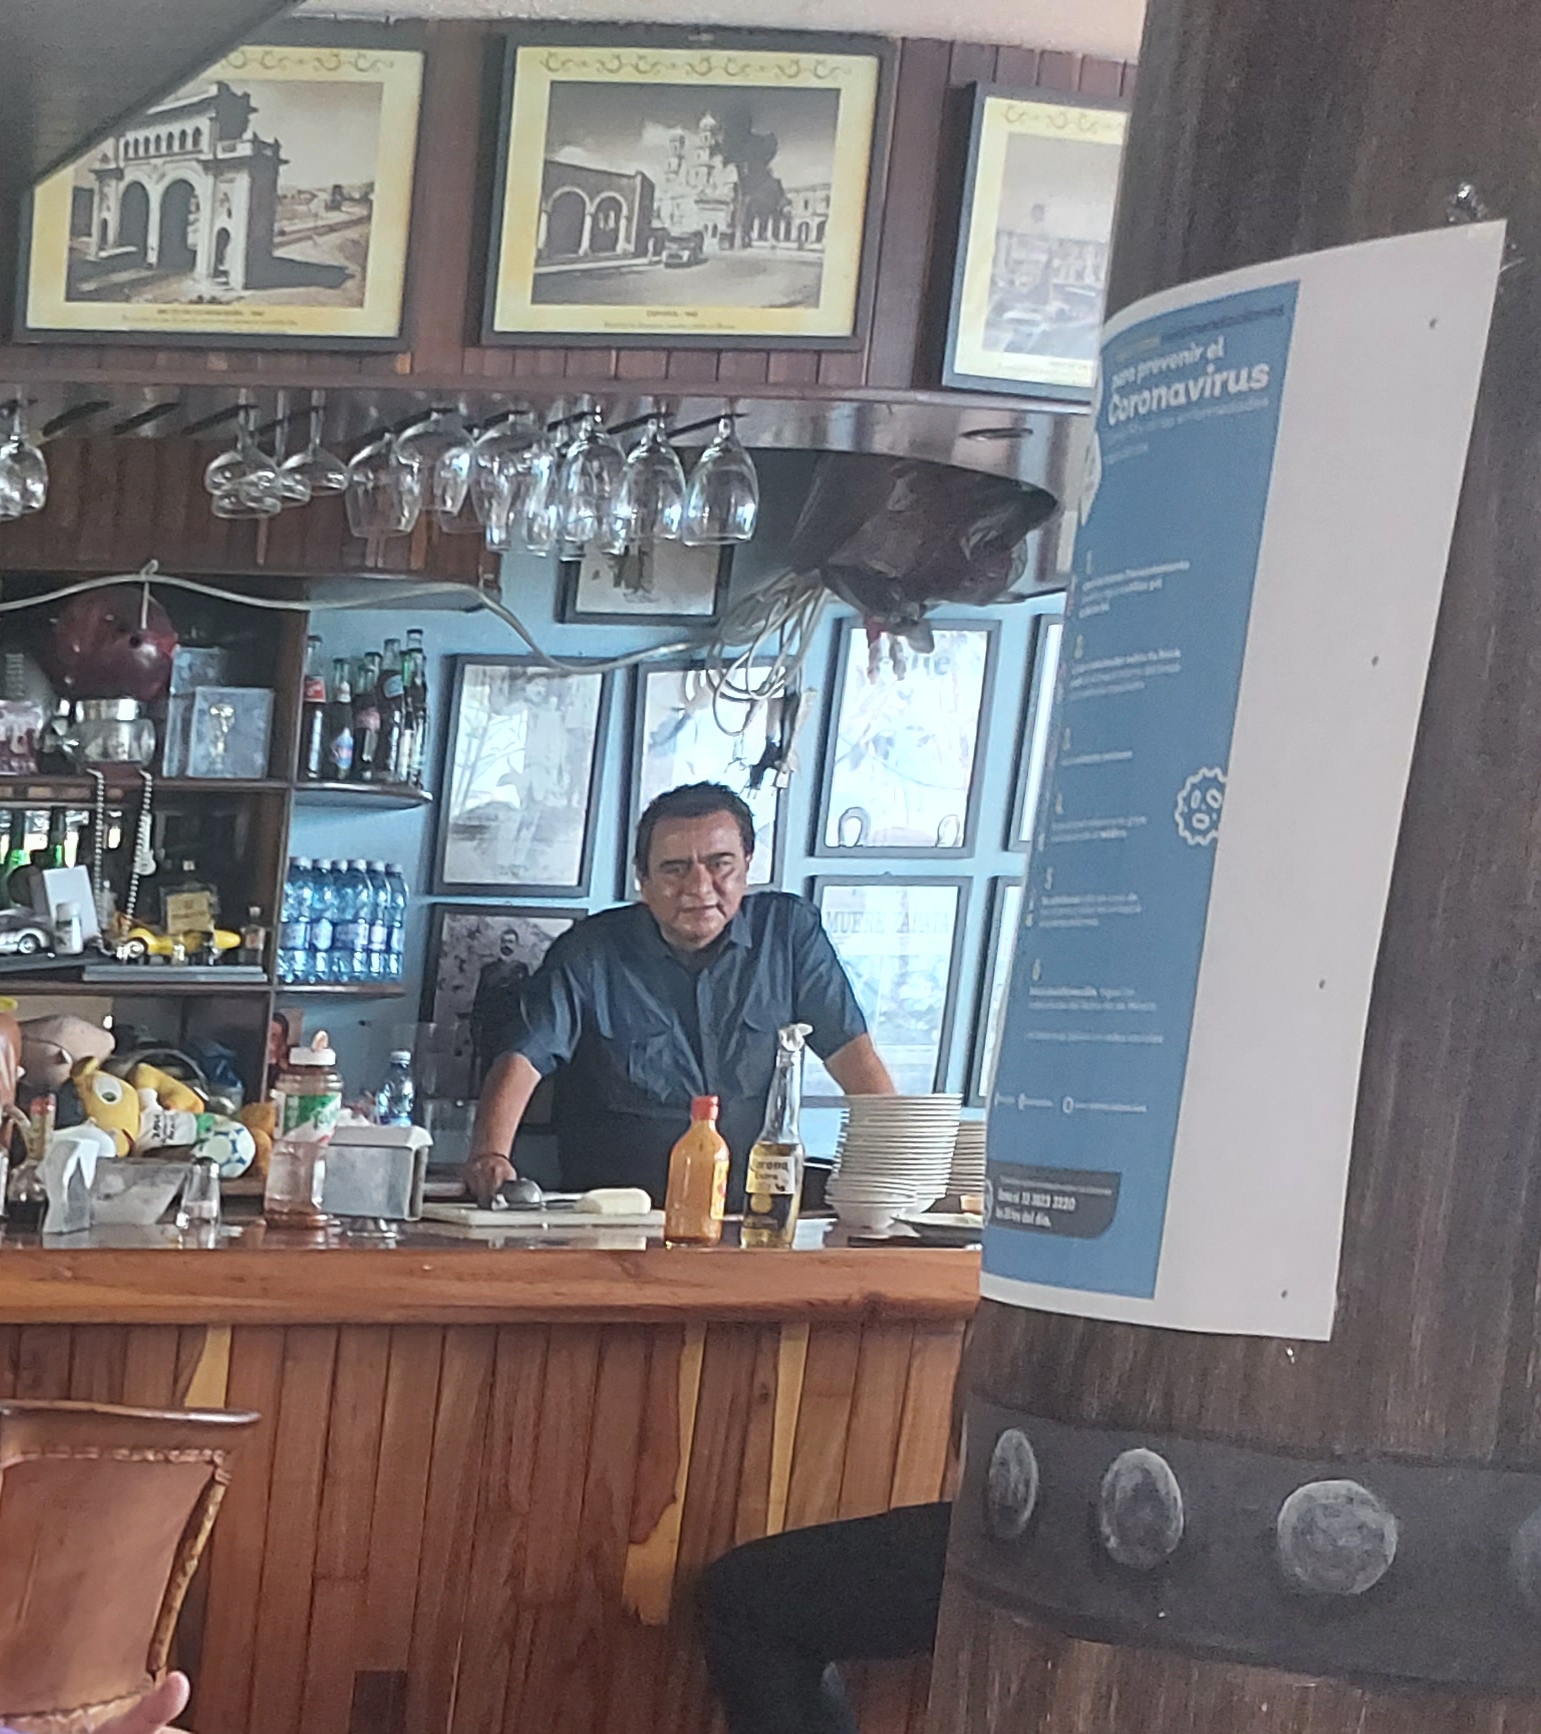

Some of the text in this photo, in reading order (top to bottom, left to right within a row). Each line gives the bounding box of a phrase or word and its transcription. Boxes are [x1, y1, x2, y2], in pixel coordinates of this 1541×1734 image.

[1136, 341, 1205, 385] prevenir
[1205, 334, 1225, 360] el
[1107, 362, 1271, 427] Coronavirus
